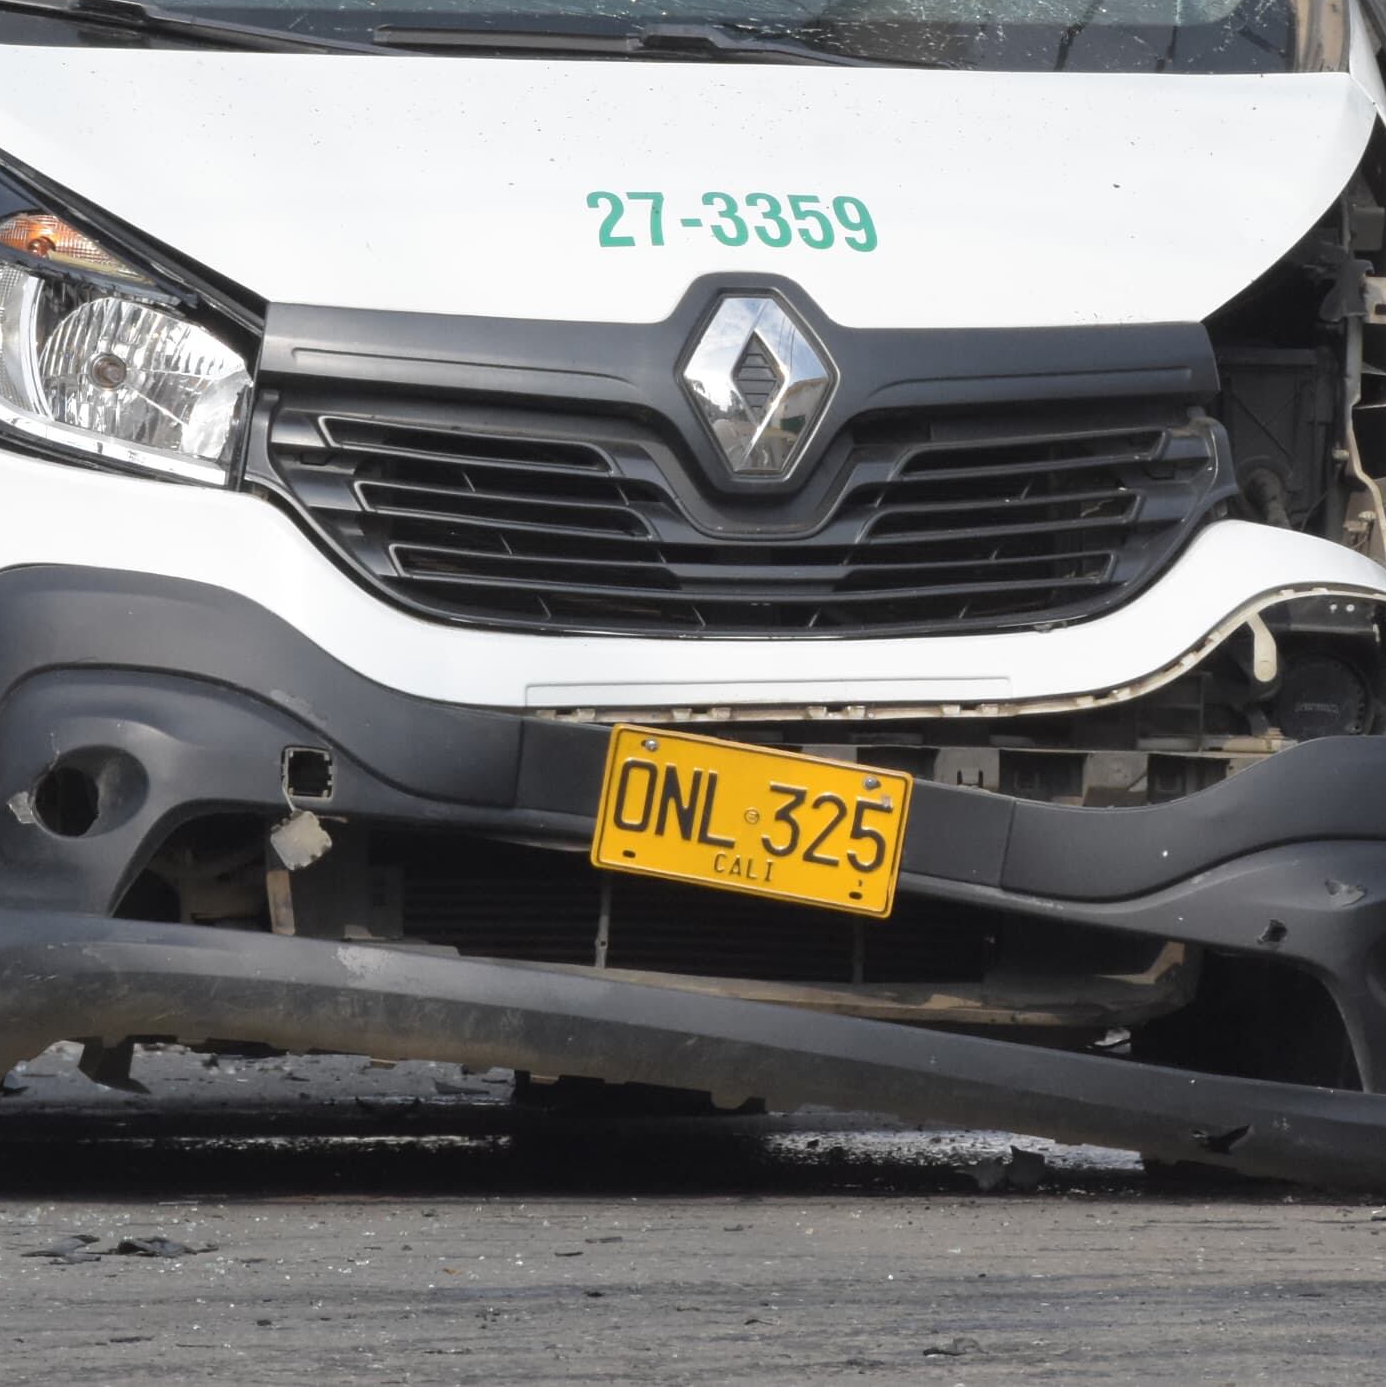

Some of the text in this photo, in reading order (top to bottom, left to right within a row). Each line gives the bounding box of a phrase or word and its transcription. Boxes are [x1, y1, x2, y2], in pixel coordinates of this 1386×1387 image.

[586, 191, 878, 252] 27-3359
[613, 757, 894, 874] ONL 325
[713, 851, 775, 883] CALI
